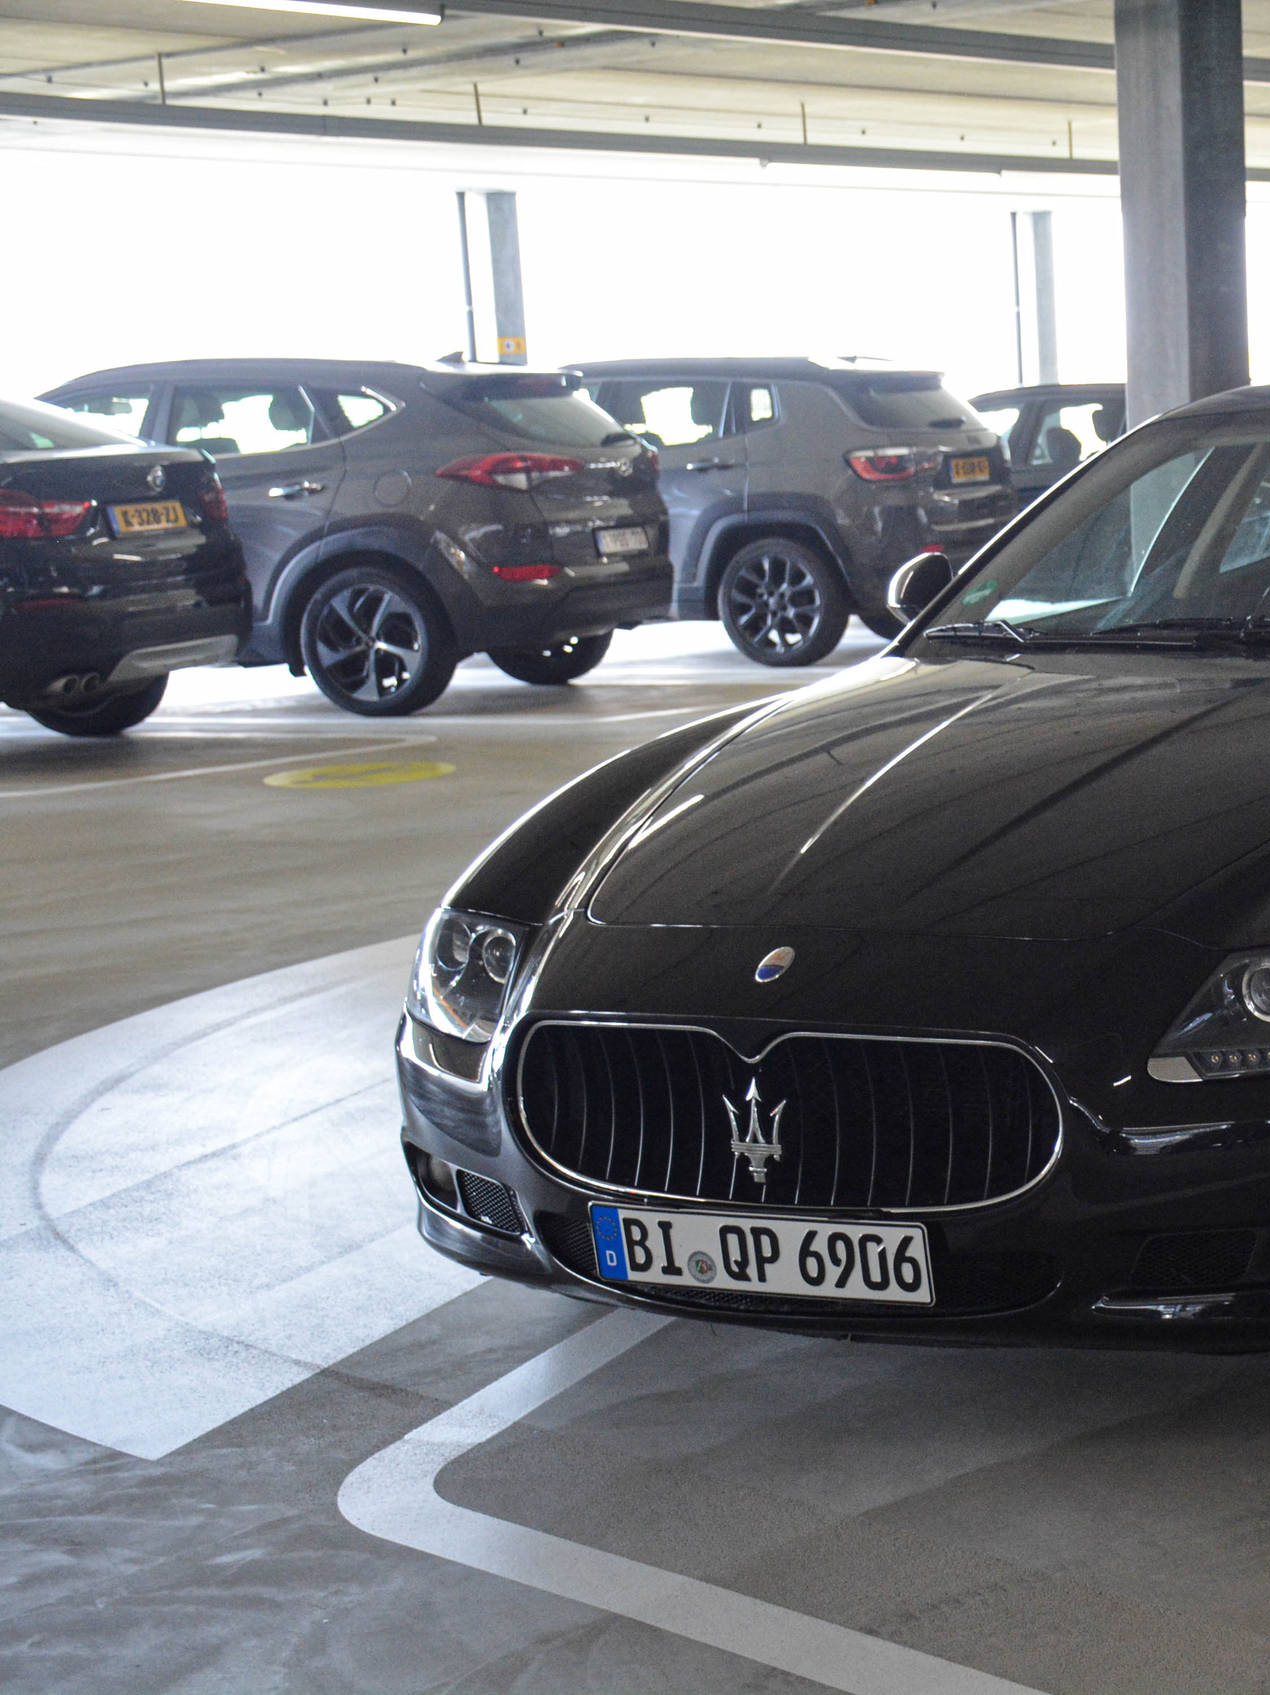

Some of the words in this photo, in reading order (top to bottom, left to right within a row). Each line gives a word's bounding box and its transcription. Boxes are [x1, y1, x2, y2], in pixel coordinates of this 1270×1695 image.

[605, 1250, 618, 1267] D
[622, 1217, 684, 1277] BI
[719, 1224, 780, 1283] QP
[798, 1229, 922, 1293] 6906
